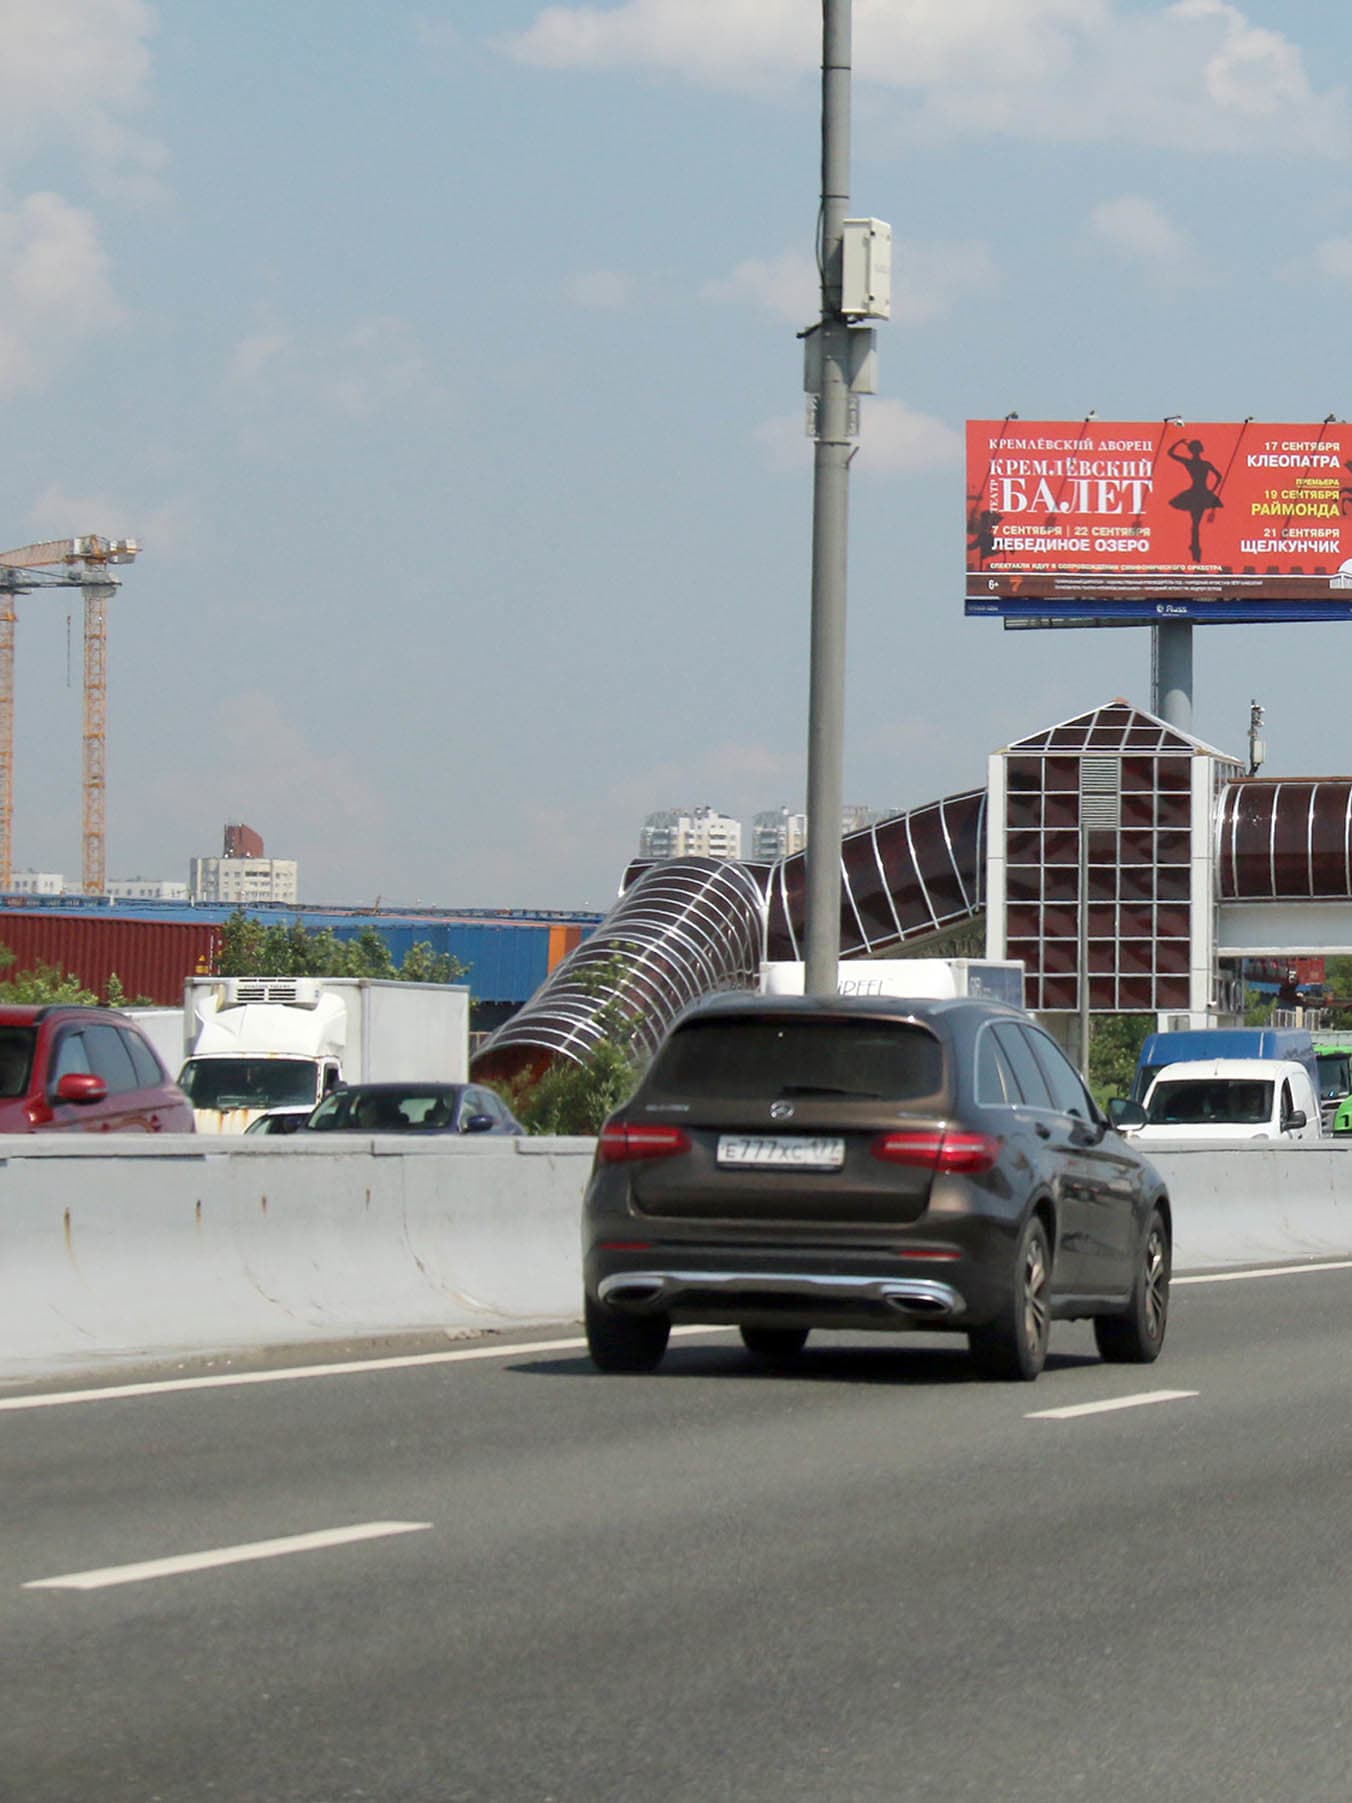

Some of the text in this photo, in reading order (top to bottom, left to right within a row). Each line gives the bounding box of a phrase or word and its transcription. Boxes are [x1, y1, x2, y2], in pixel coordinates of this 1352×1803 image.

[1098, 441, 1152, 451] ДВОРЕЦ
[1265, 442, 1340, 451] 17 СЕНТЯБРЯ
[990, 457, 1152, 477] КРЕМЛЁВСКИЙ
[1247, 455, 1340, 467] КЛЕОПАТРА
[999, 478, 1153, 515] БАЛЕТ
[1265, 490, 1340, 499] 19 СЕНТЯБРЯ
[1251, 501, 1340, 518] РАЙМОНДА
[992, 525, 1151, 536] 7 СЕНТЯБРЯ 22 СЕНТЯБРЯ
[1264, 528, 1340, 538] 21 СЕНТЯБРЯ
[992, 538, 1150, 552] ЛЕБЕДИНОЕ ОЗЕРО
[1241, 540, 1340, 554] ЩЕЛКУНЧИК
